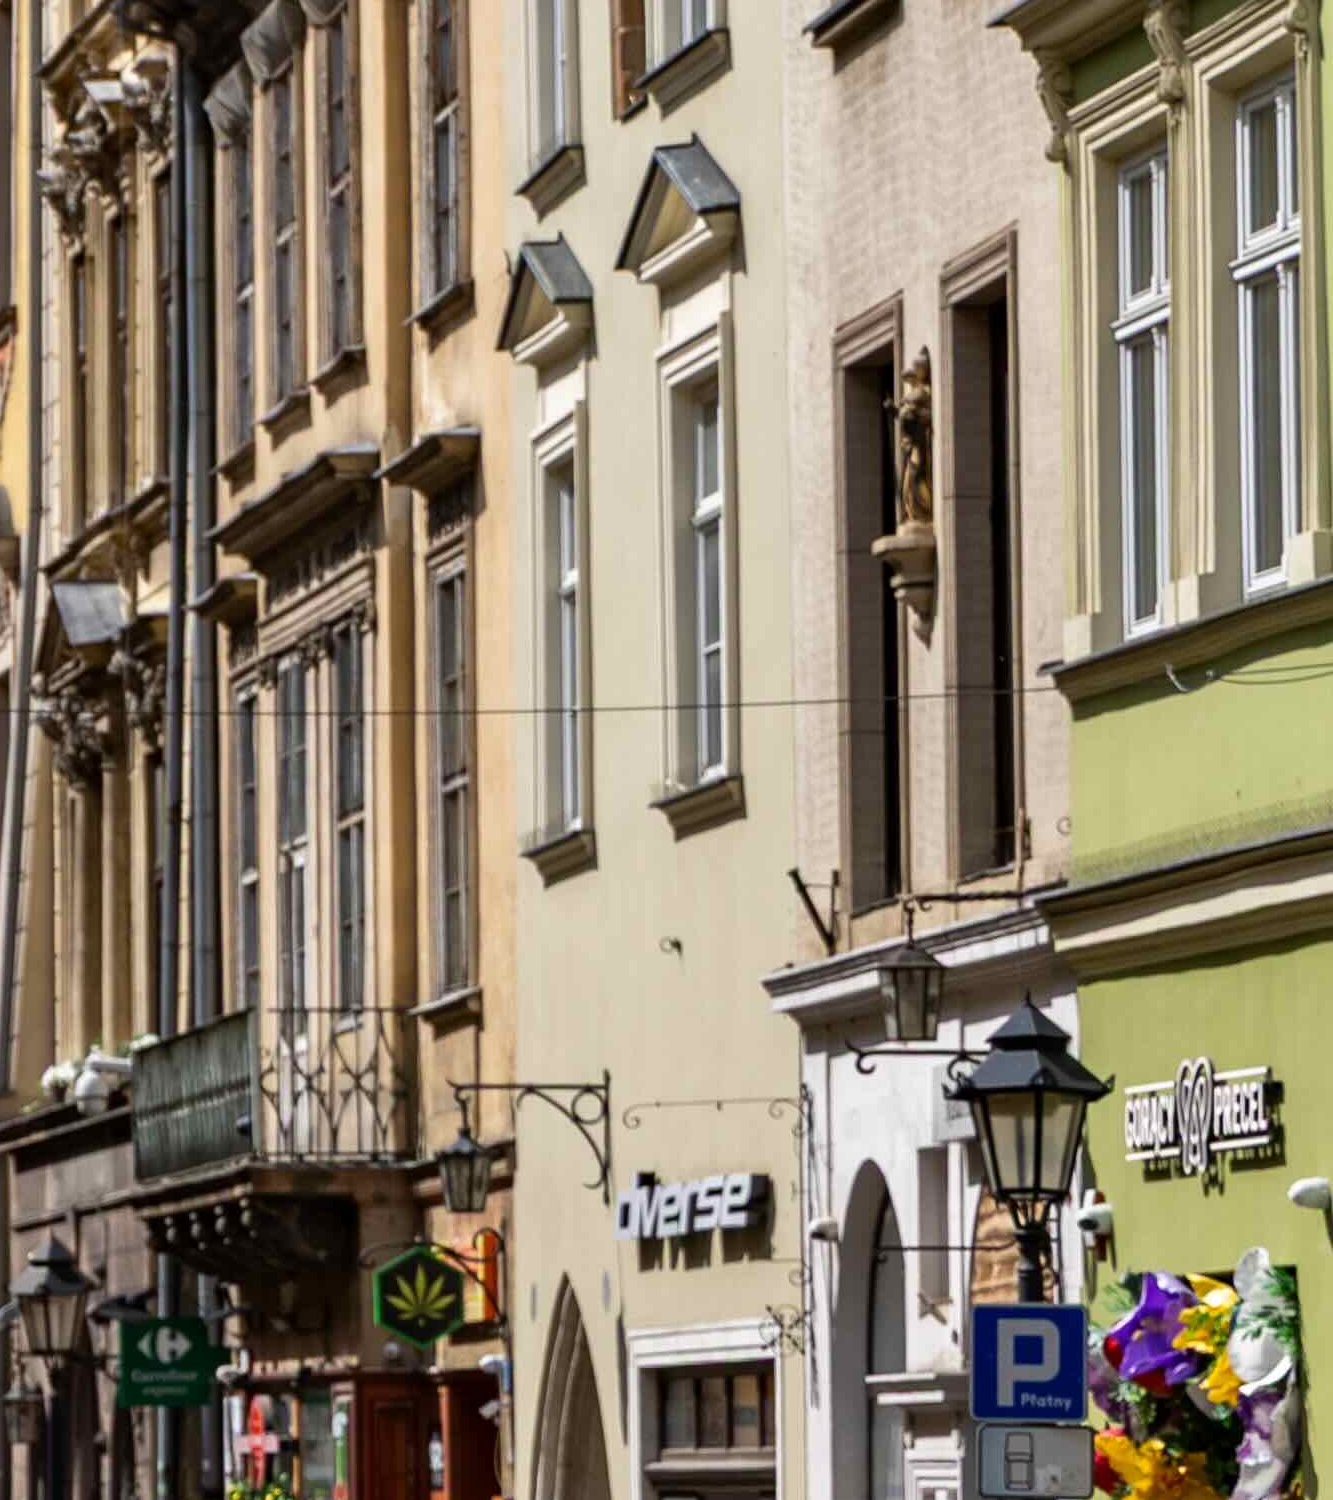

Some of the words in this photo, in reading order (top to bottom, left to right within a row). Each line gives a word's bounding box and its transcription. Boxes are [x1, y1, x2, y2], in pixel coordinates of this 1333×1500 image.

[1124, 1095, 1175, 1153] GORĄCY
[1213, 1080, 1270, 1137] PRECEL
[997, 1318, 1061, 1407] P
[1020, 1392, 1073, 1412] Płatny
